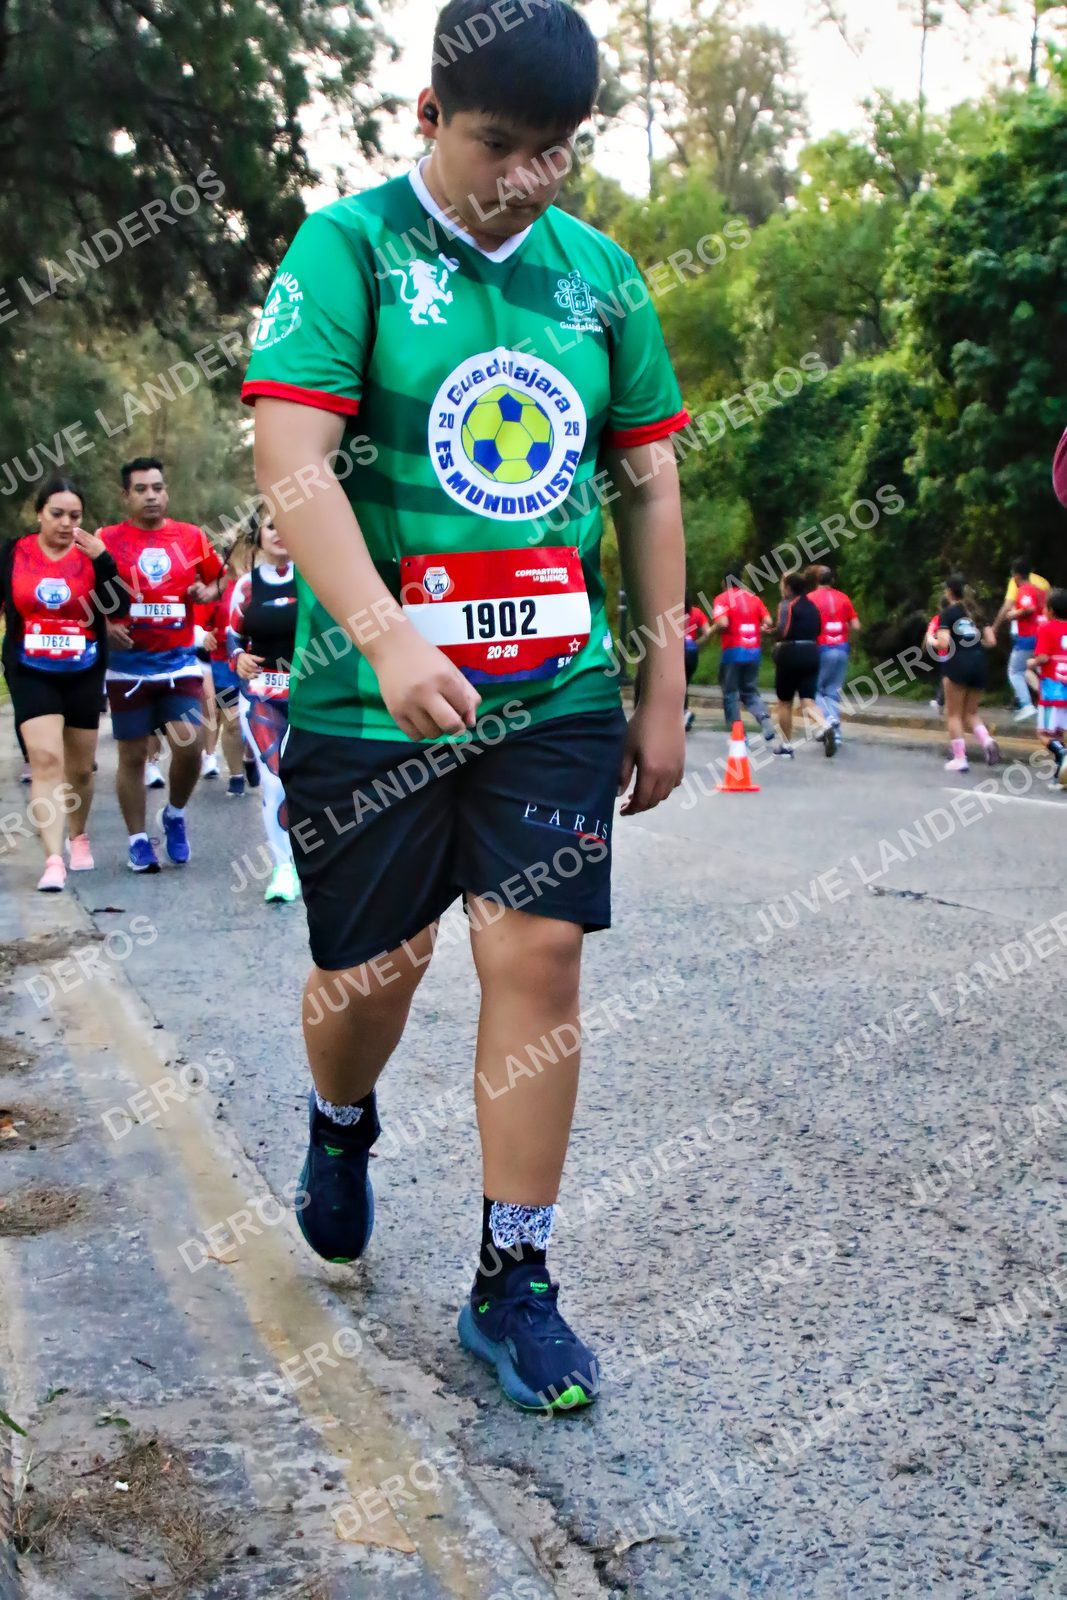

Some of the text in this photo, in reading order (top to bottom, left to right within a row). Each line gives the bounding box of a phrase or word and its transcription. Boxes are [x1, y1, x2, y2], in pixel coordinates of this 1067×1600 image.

[438, 412, 455, 429] 20
[564, 421, 580, 436] 26
[435, 440, 580, 514] ES MUNDIALISTA
[144, 604, 172, 615] 17626
[462, 599, 537, 640] 1902
[41, 636, 70, 647] 17624
[523, 803, 607, 840] PARIS
